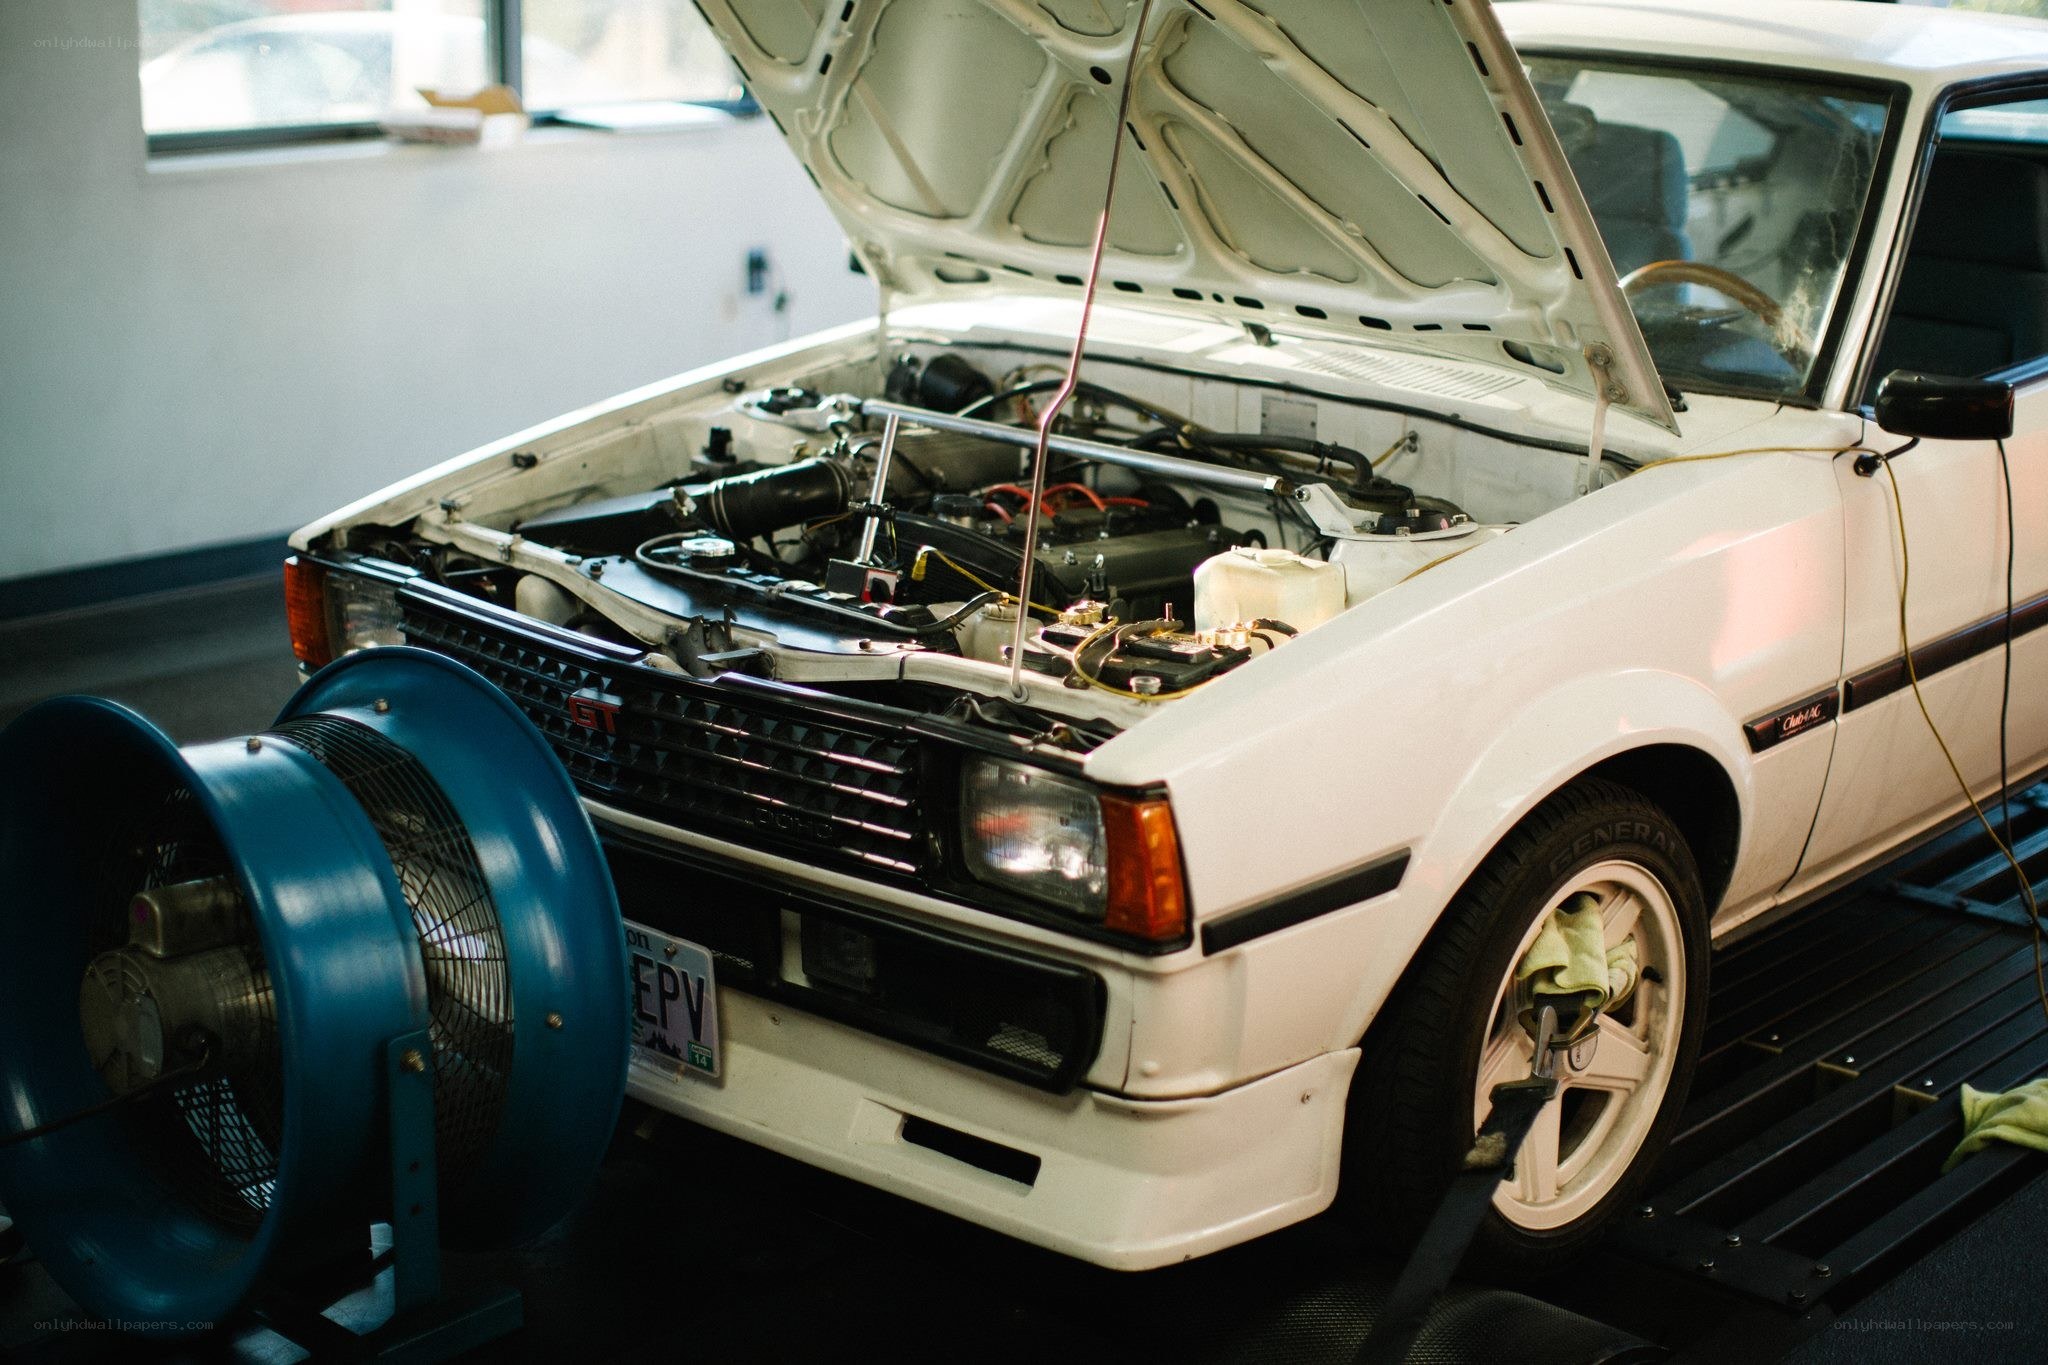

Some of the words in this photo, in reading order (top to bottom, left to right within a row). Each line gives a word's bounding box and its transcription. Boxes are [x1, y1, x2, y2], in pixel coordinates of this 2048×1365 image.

[568, 696, 621, 734] GT
[1550, 821, 1682, 876] GENERAL
[632, 952, 705, 1042] EPV
[694, 1053, 708, 1068] 14
